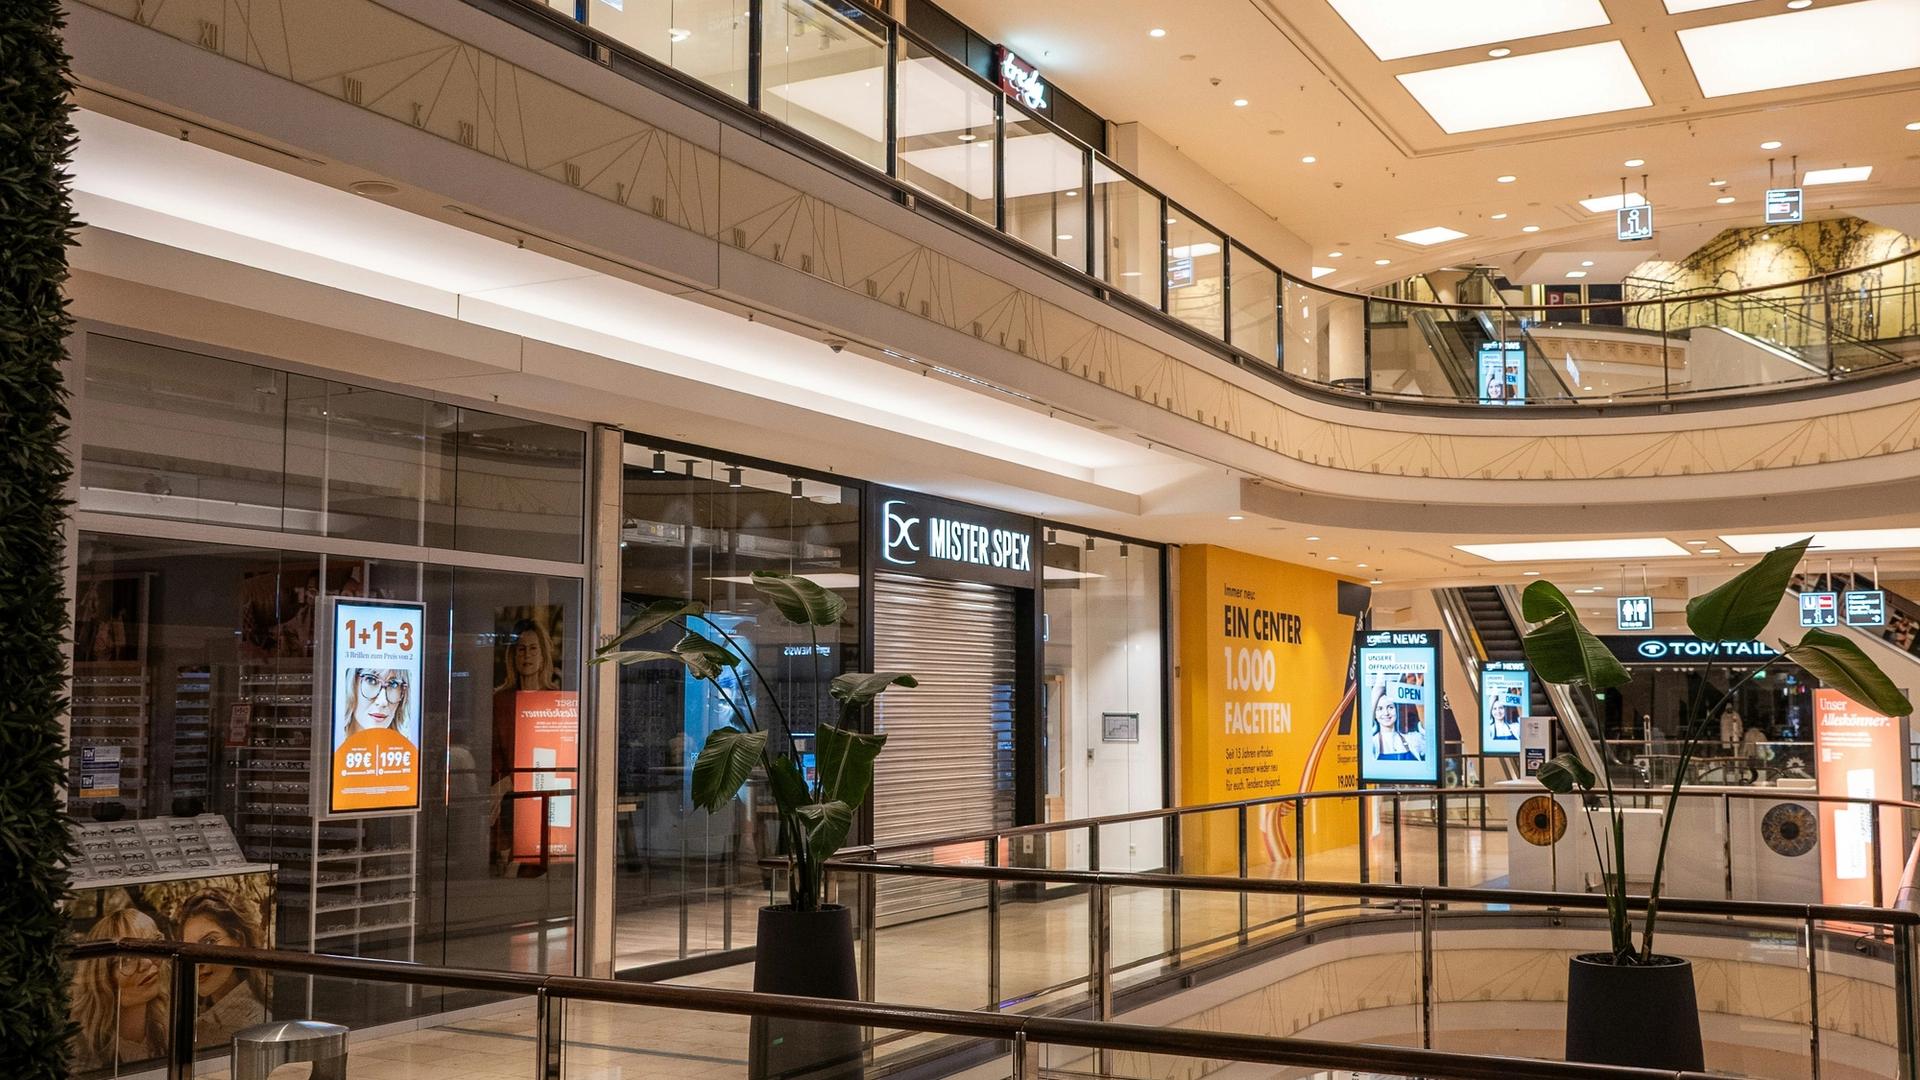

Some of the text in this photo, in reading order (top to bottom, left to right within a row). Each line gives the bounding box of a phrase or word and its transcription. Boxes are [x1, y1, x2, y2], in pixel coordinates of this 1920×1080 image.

[928, 517, 1031, 572] MISTER SPEX
[345, 619, 414, 652] 1+1=3
[1224, 605, 1302, 645] EIN CENTER
[1392, 633, 1428, 645] NEWS
[1669, 641, 1780, 655] TOM TAIL
[1224, 646, 1276, 692] 1.000
[1398, 686, 1421, 701] OPEN
[1820, 698, 1847, 711] Unser
[1224, 701, 1292, 735] FACETTEN
[380, 751, 411, 768] 199€
